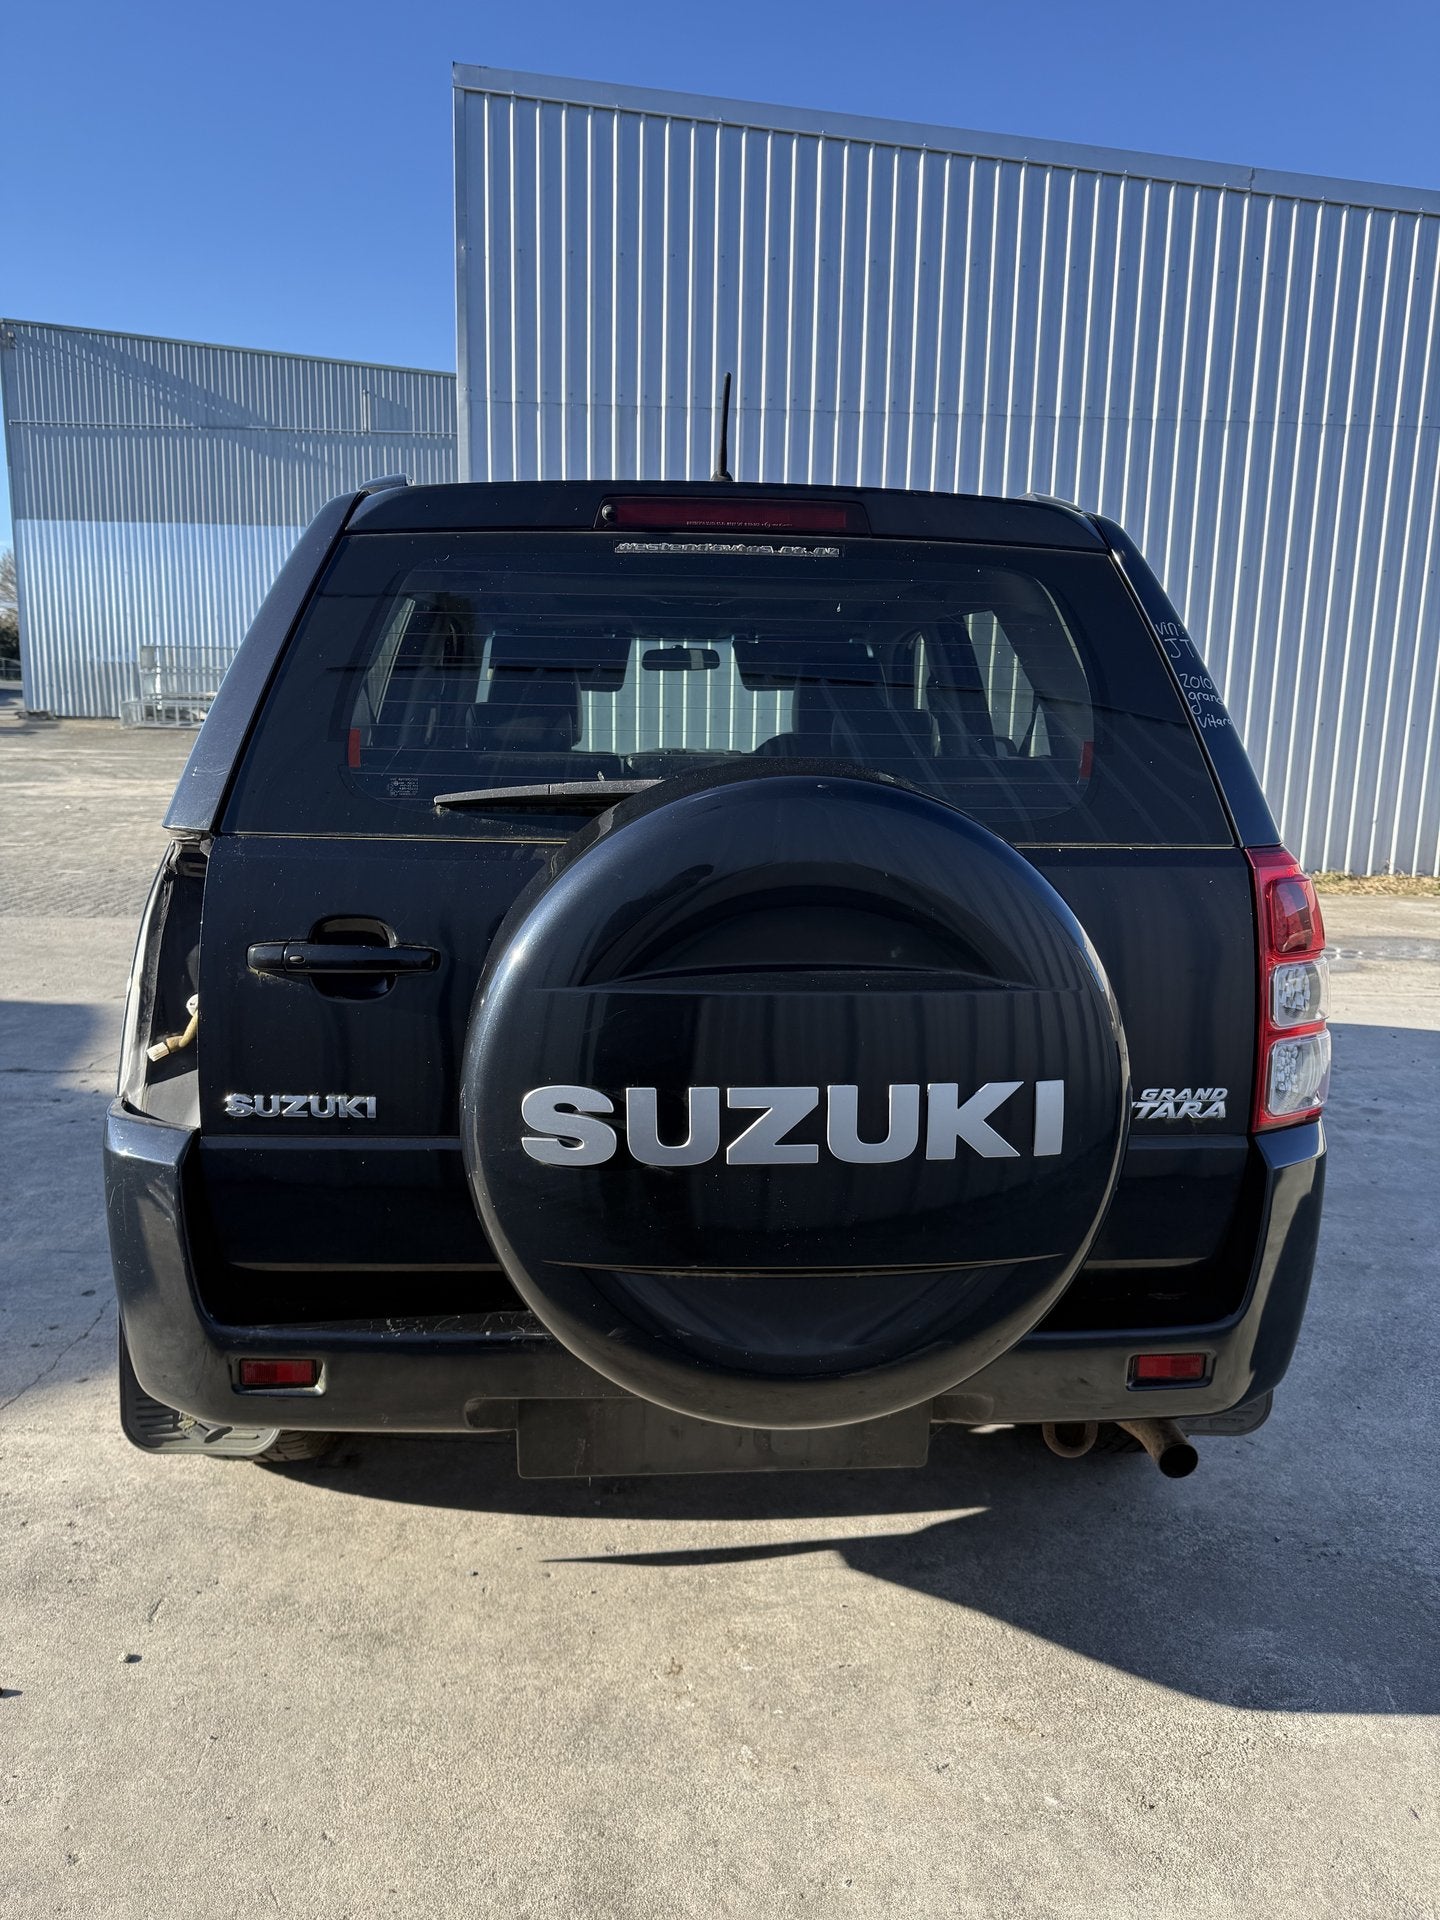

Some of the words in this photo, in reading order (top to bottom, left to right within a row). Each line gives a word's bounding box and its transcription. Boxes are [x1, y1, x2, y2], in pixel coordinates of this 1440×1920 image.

[1179, 673, 1214, 690] 2010
[1140, 1088, 1229, 1101] GRAND
[224, 1093, 378, 1119] SUZUKI
[1132, 1100, 1226, 1119] TARA
[520, 1079, 1065, 1166] SUZUKI
